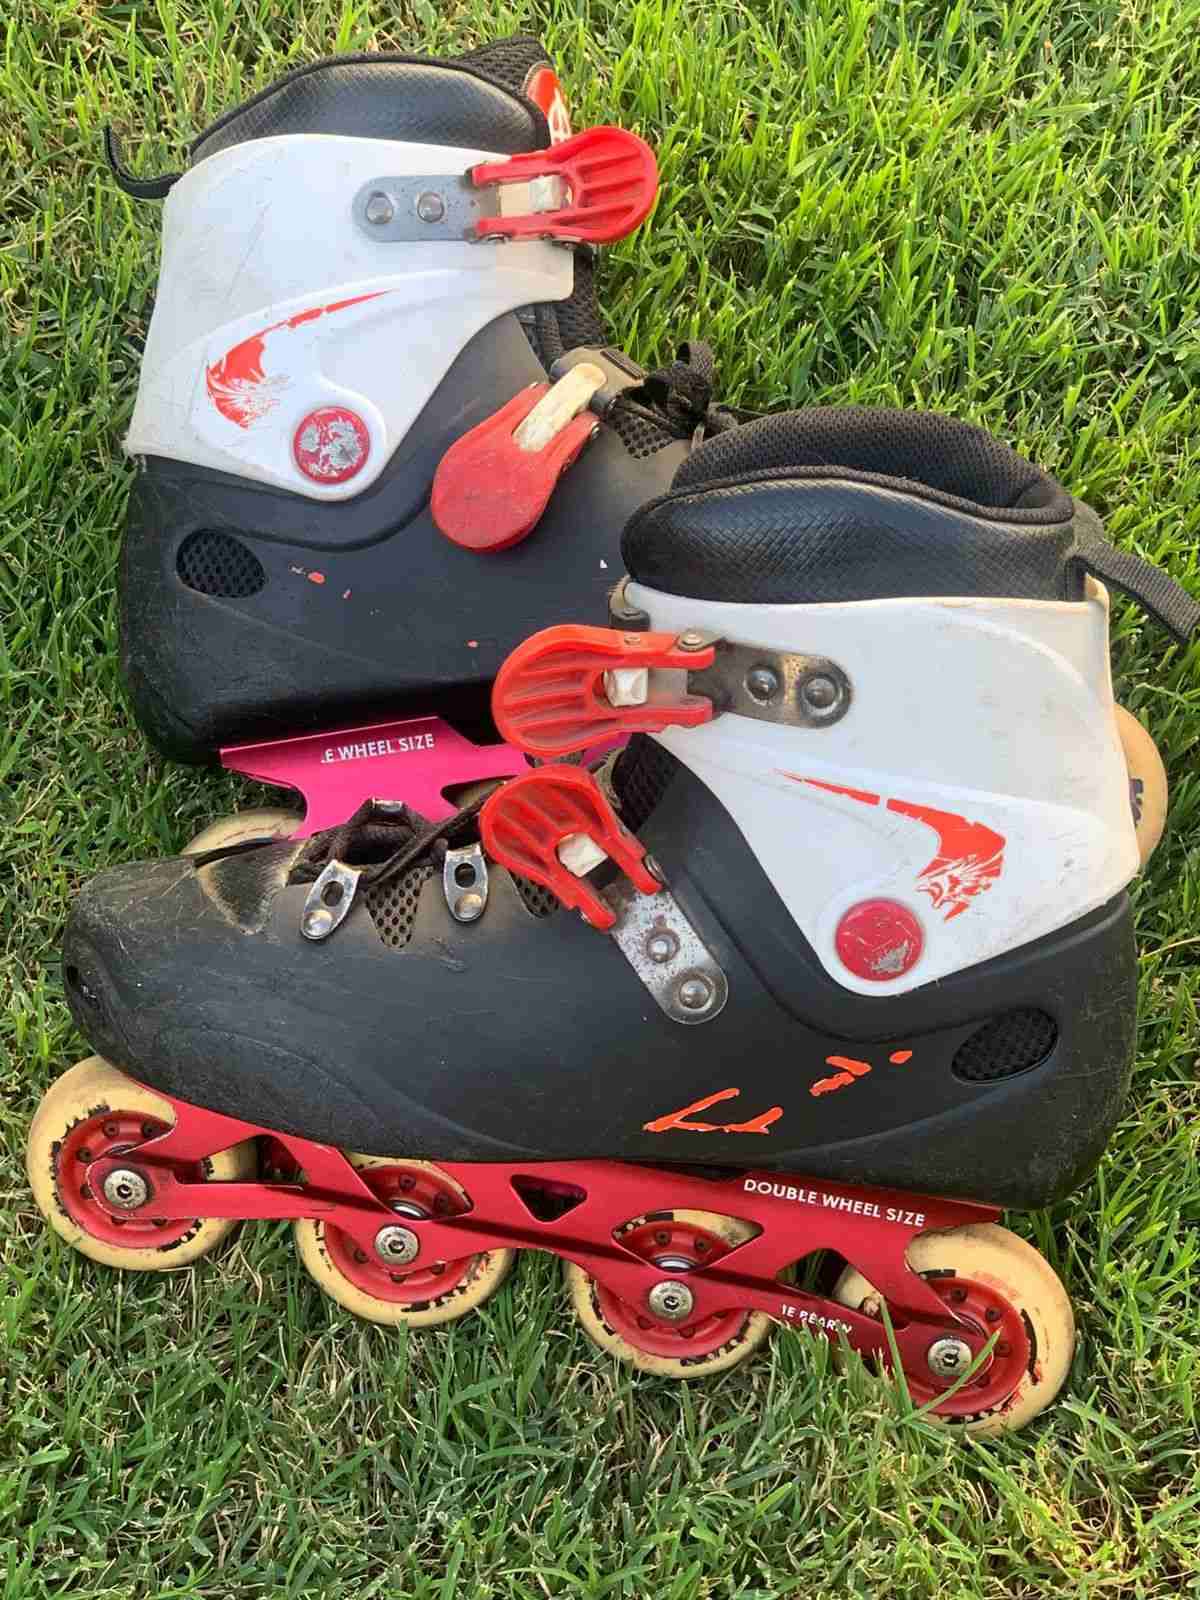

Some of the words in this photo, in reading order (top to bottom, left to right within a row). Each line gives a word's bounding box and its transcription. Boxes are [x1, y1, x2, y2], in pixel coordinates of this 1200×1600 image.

[337, 740, 395, 761] WHEEL
[398, 733, 435, 752] SIZE
[743, 1178, 818, 1205] DOUBLE
[822, 1194, 881, 1218] WHEEL
[886, 1207, 926, 1227] SIZE
